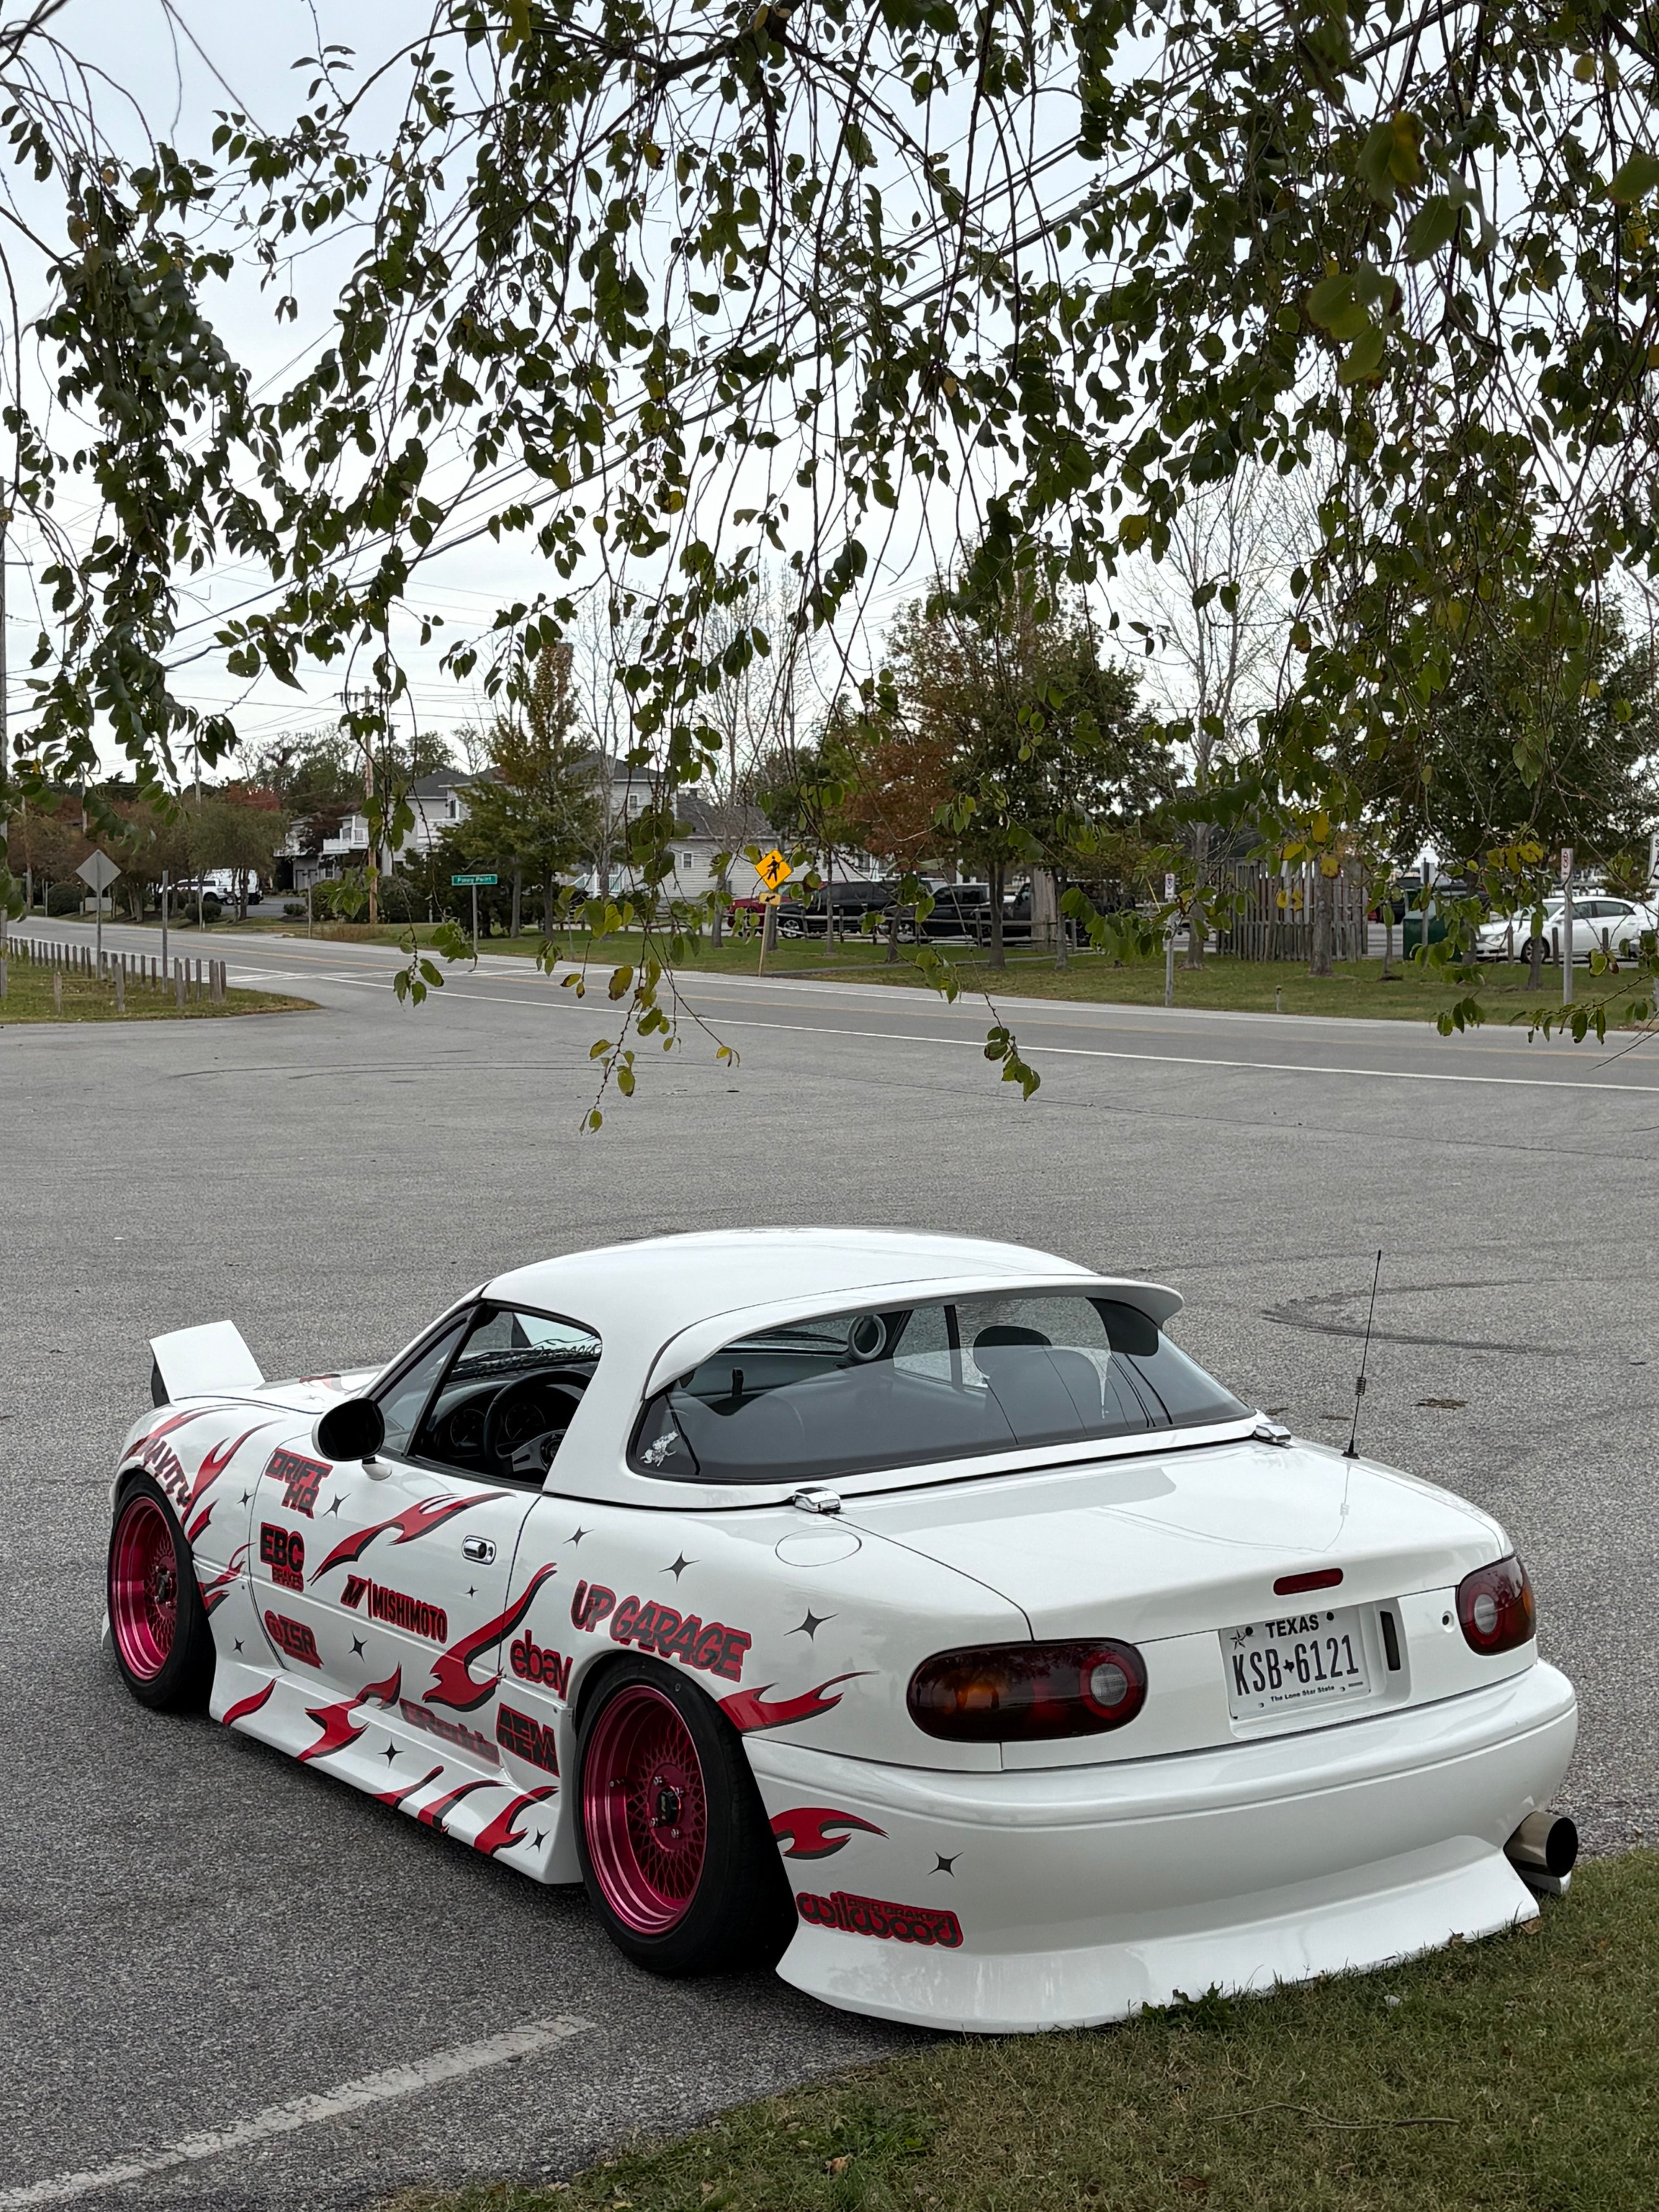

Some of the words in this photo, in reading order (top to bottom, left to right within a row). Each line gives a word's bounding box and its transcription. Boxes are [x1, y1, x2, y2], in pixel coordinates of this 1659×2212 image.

[265, 1450, 333, 1488] DRIFT
[282, 1482, 318, 1516] HQ
[260, 1522, 305, 1572] EBC
[373, 1583, 448, 1643] MISHIMOTO
[571, 1580, 617, 1632] UP
[610, 1595, 751, 1682] GARAGE
[1265, 1615, 1319, 1638] TEXAS
[510, 1629, 573, 1701] ebay
[1232, 1649, 1283, 1696] KSB
[1294, 1634, 1359, 1683] 6121
[497, 1703, 560, 1778] AEM
[796, 1891, 963, 1948] wilwood
